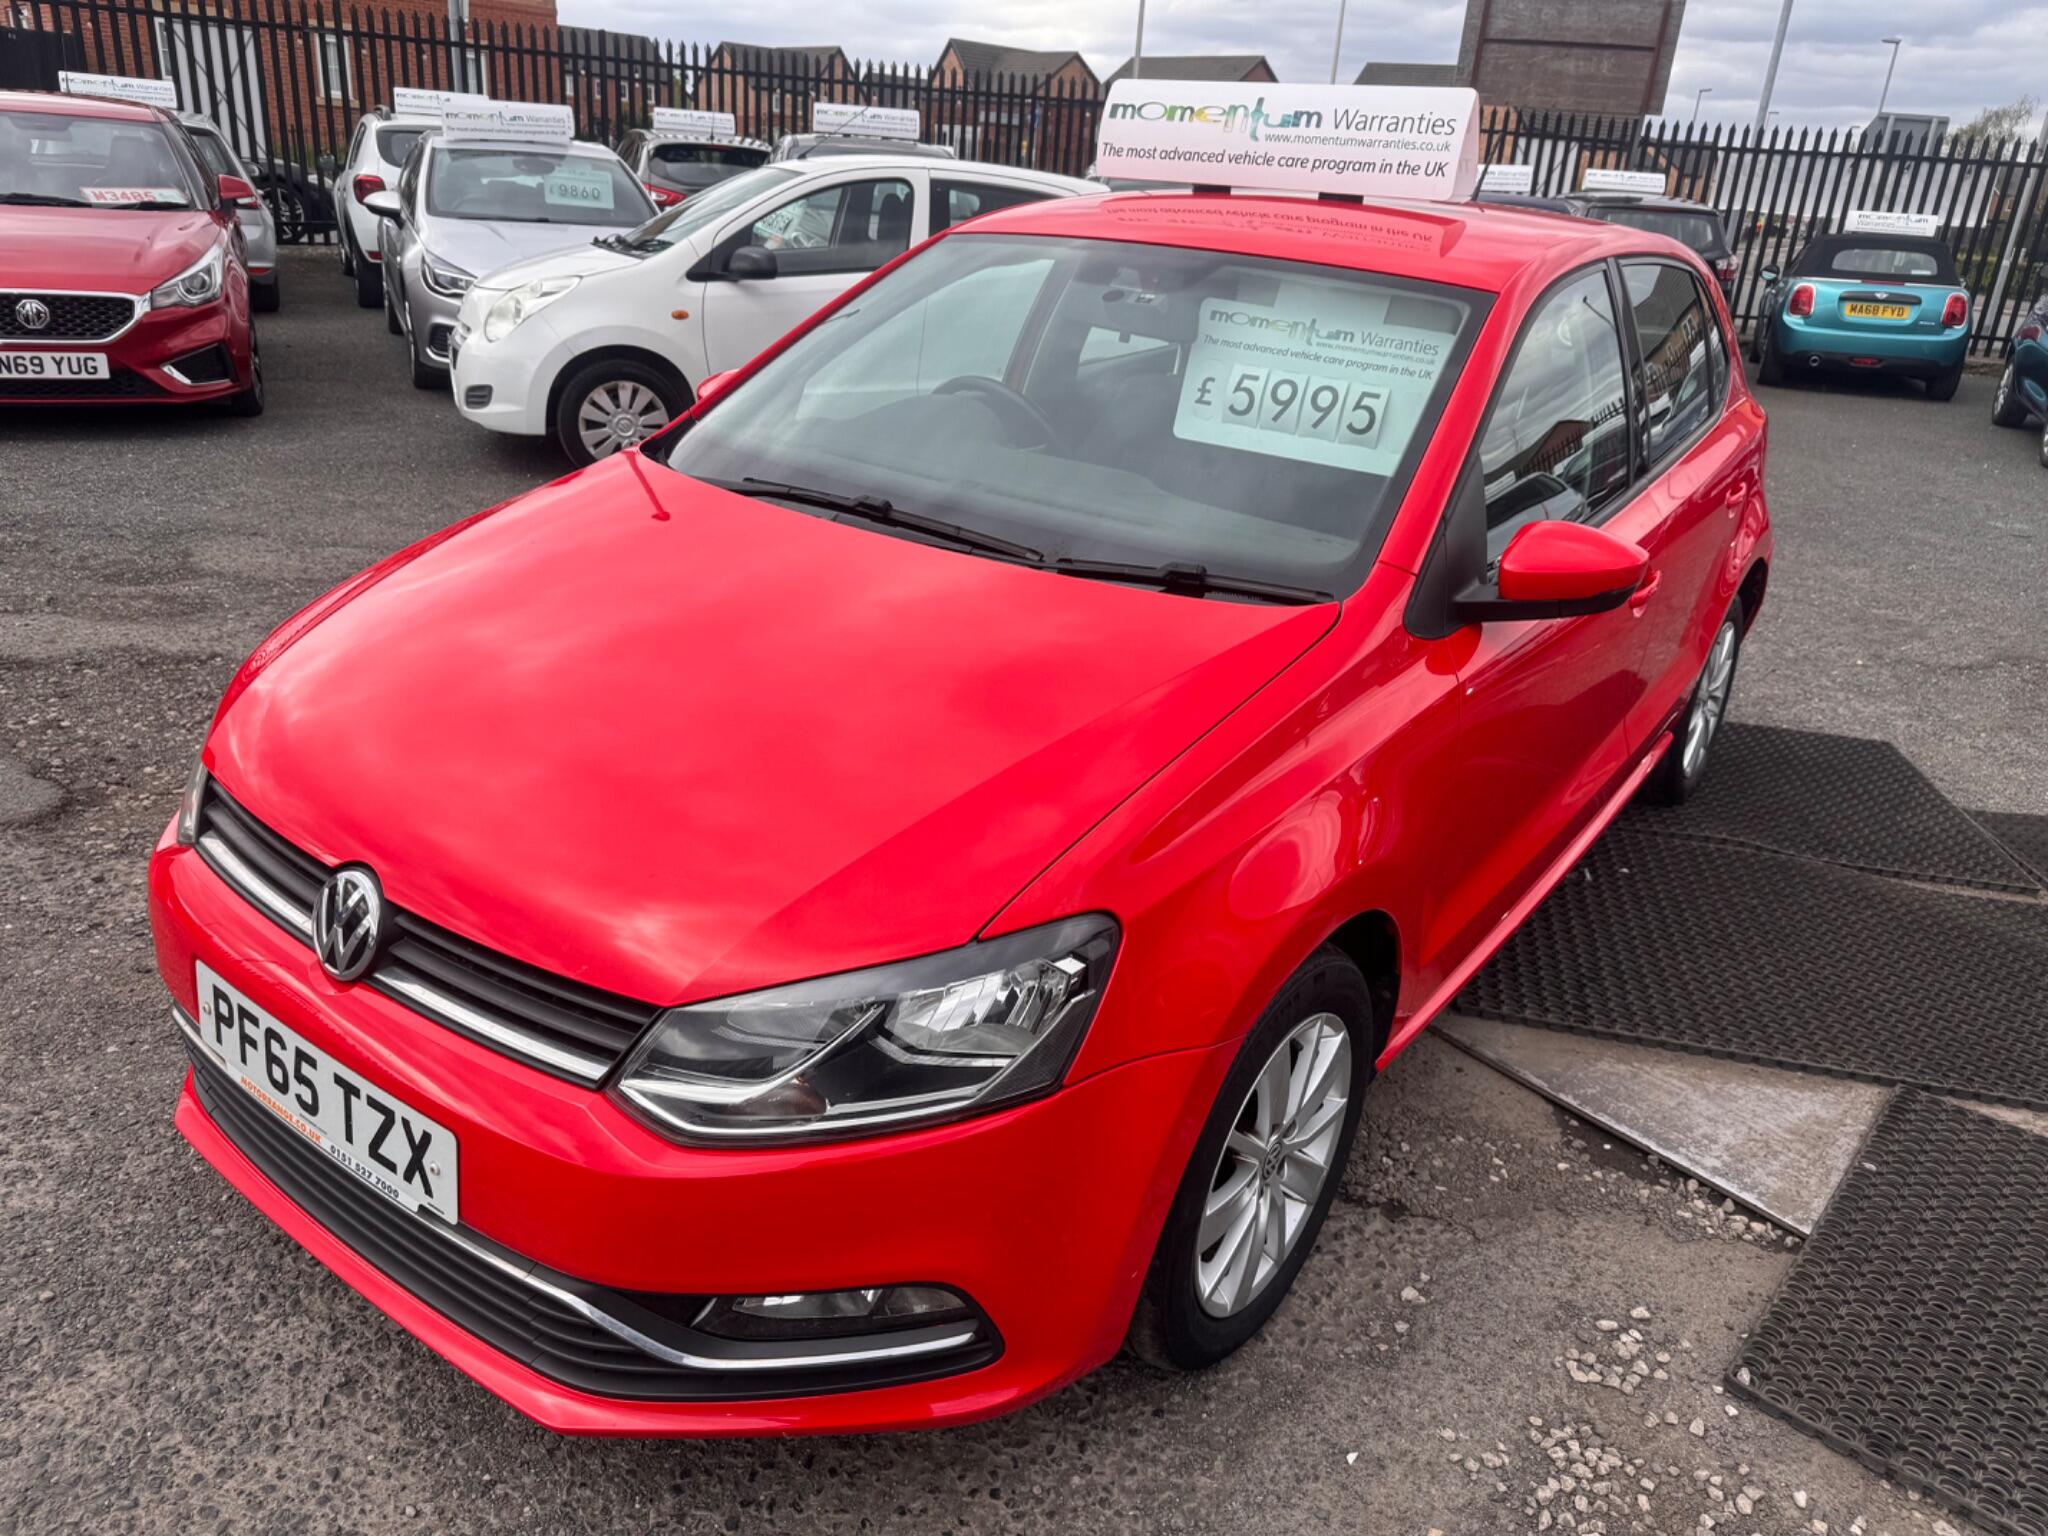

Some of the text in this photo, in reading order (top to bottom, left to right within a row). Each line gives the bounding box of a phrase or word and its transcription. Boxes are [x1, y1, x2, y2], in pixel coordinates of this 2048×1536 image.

[1108, 97, 1456, 141] momentum Warranties
[1102, 142, 1123, 157] The
[1126, 145, 1157, 160] most
[1159, 147, 1225, 164] advanced
[1228, 151, 1275, 167] vehicle
[1277, 156, 1308, 169] care
[1311, 158, 1376, 175] program
[1379, 160, 1393, 174] in
[1397, 160, 1420, 176] the
[1424, 161, 1449, 177] UK
[1264, 132, 1451, 152] www.momentumwarranties.co.uk
[1849, 303, 1880, 316] MA68
[1209, 309, 1440, 356] momentum Warranties
[51, 355, 98, 375] YUG
[1203, 334, 1434, 380] The most advanced vehicle care program in the UK
[213, 984, 433, 1199] PF65 TZX
[330, 1145, 351, 1166] 0151
[355, 1163, 372, 1179] 527
[375, 1176, 400, 1199] 7000
